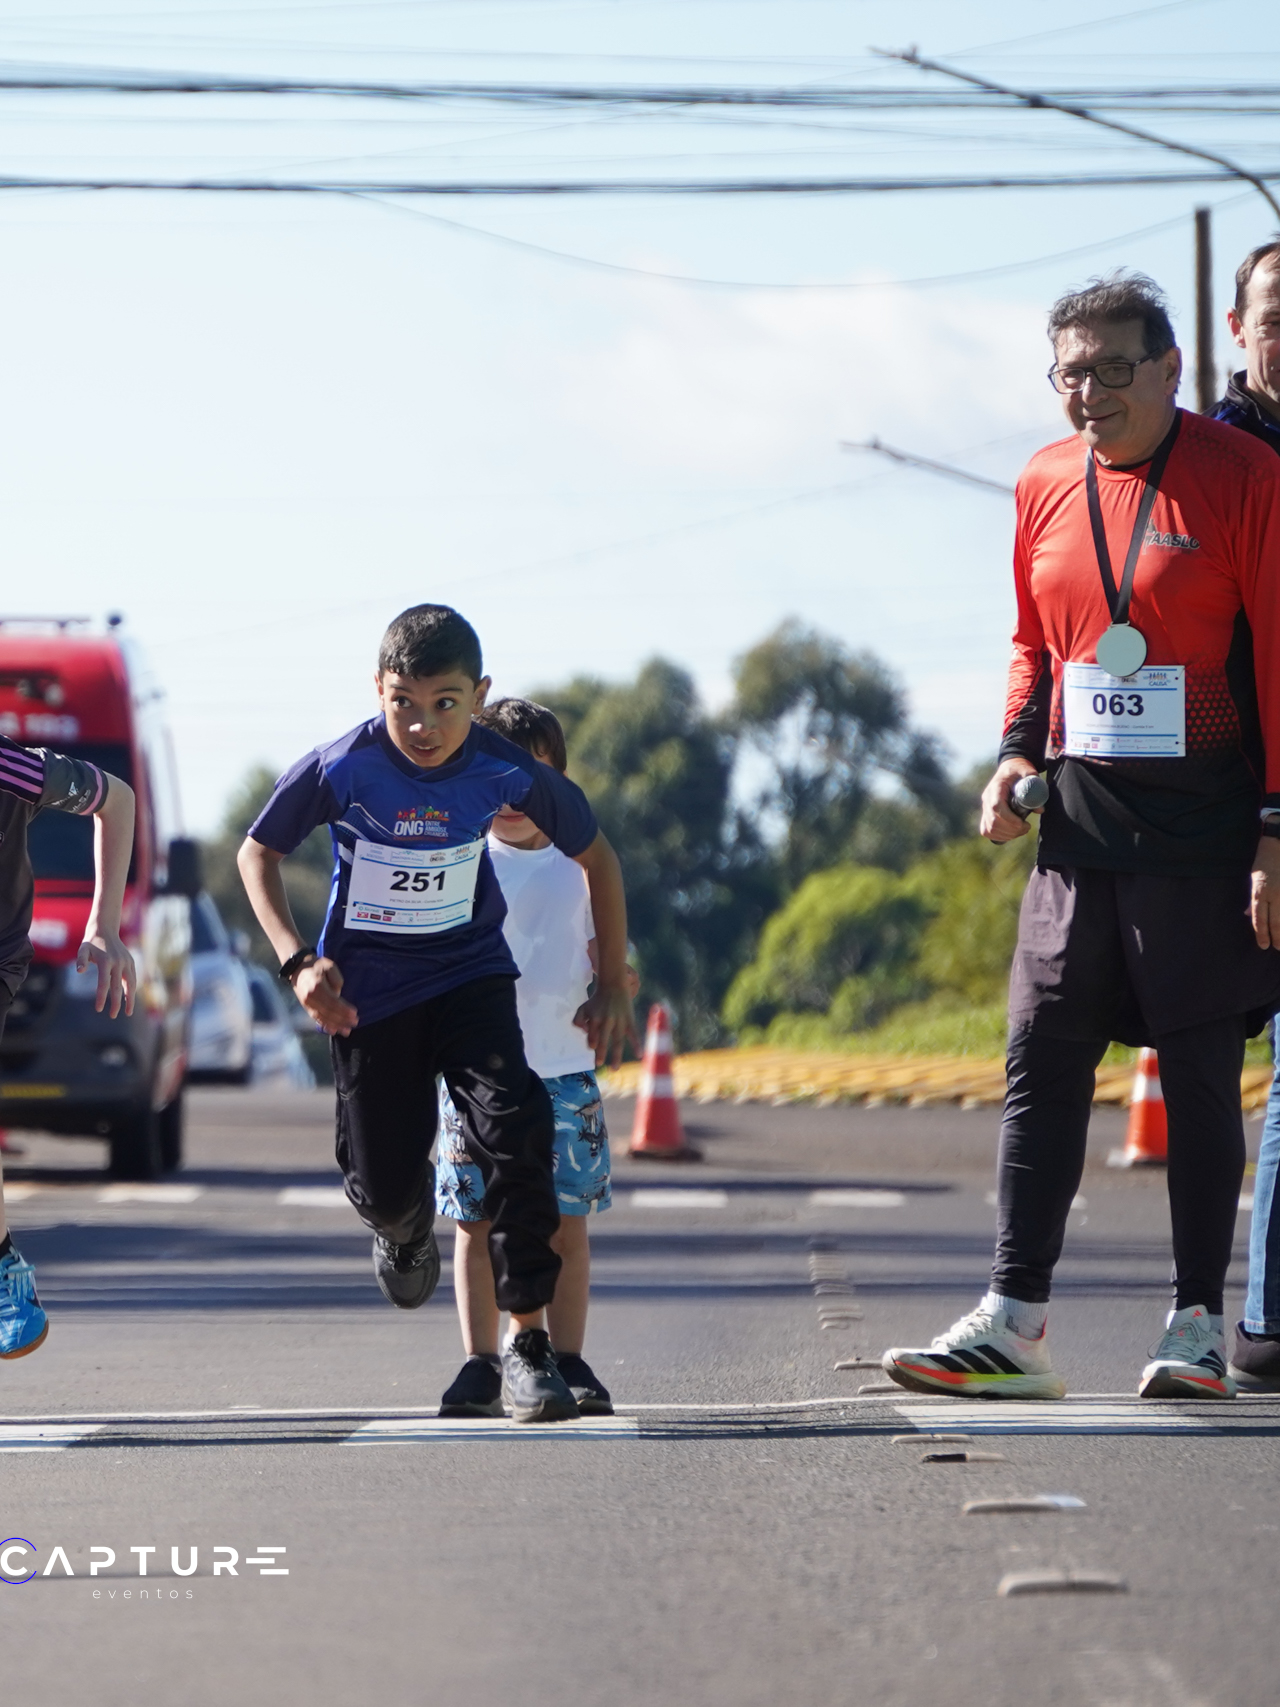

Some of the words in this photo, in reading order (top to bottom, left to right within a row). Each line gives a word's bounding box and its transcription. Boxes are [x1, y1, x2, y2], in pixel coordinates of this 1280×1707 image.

[1092, 693, 1144, 716] 063
[393, 820, 424, 836] ONG
[390, 870, 446, 892] 251
